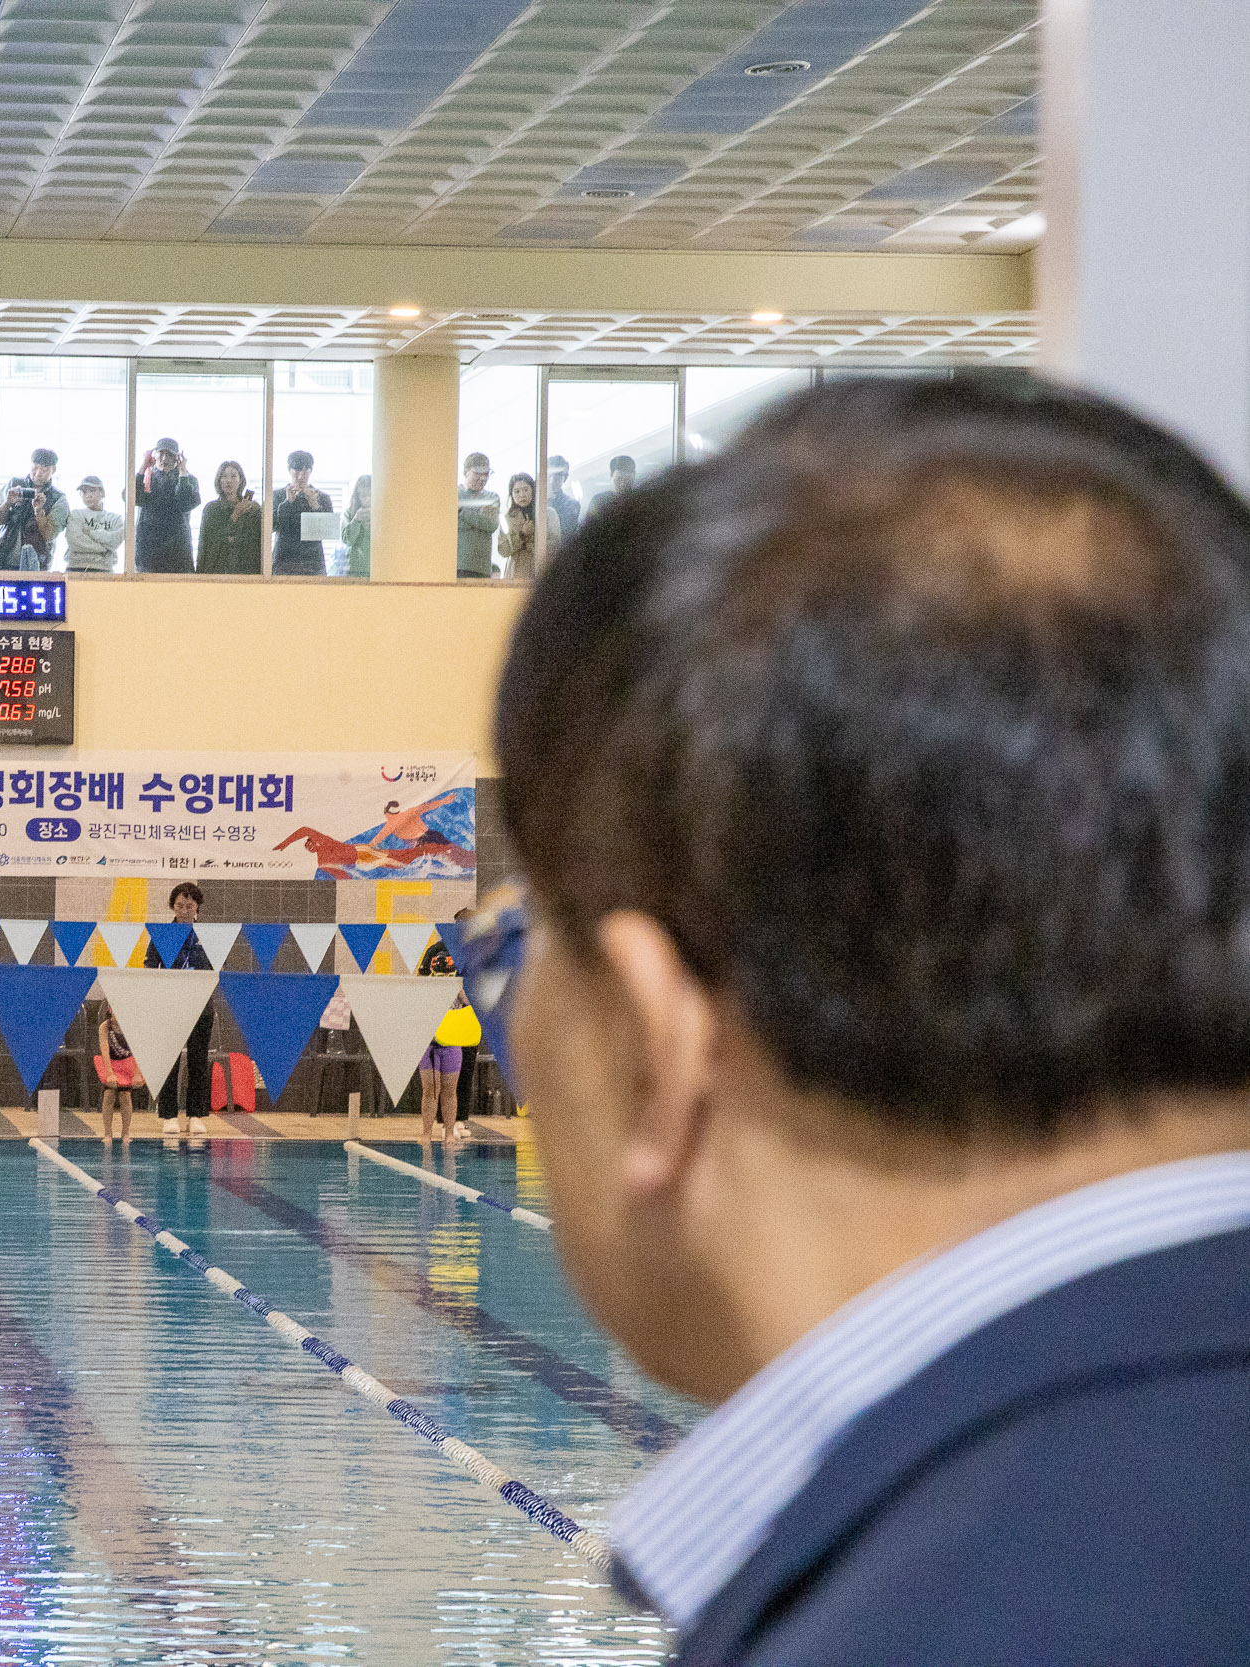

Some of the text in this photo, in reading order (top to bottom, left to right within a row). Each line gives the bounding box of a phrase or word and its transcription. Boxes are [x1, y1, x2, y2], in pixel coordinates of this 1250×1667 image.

[28, 637, 53, 650] 현황
[39, 684, 51, 695] pH
[38, 707, 61, 719] mg/L
[139, 773, 294, 814] 수영대회
[38, 822, 257, 841] 장소 광진구민체육센터 수영장
